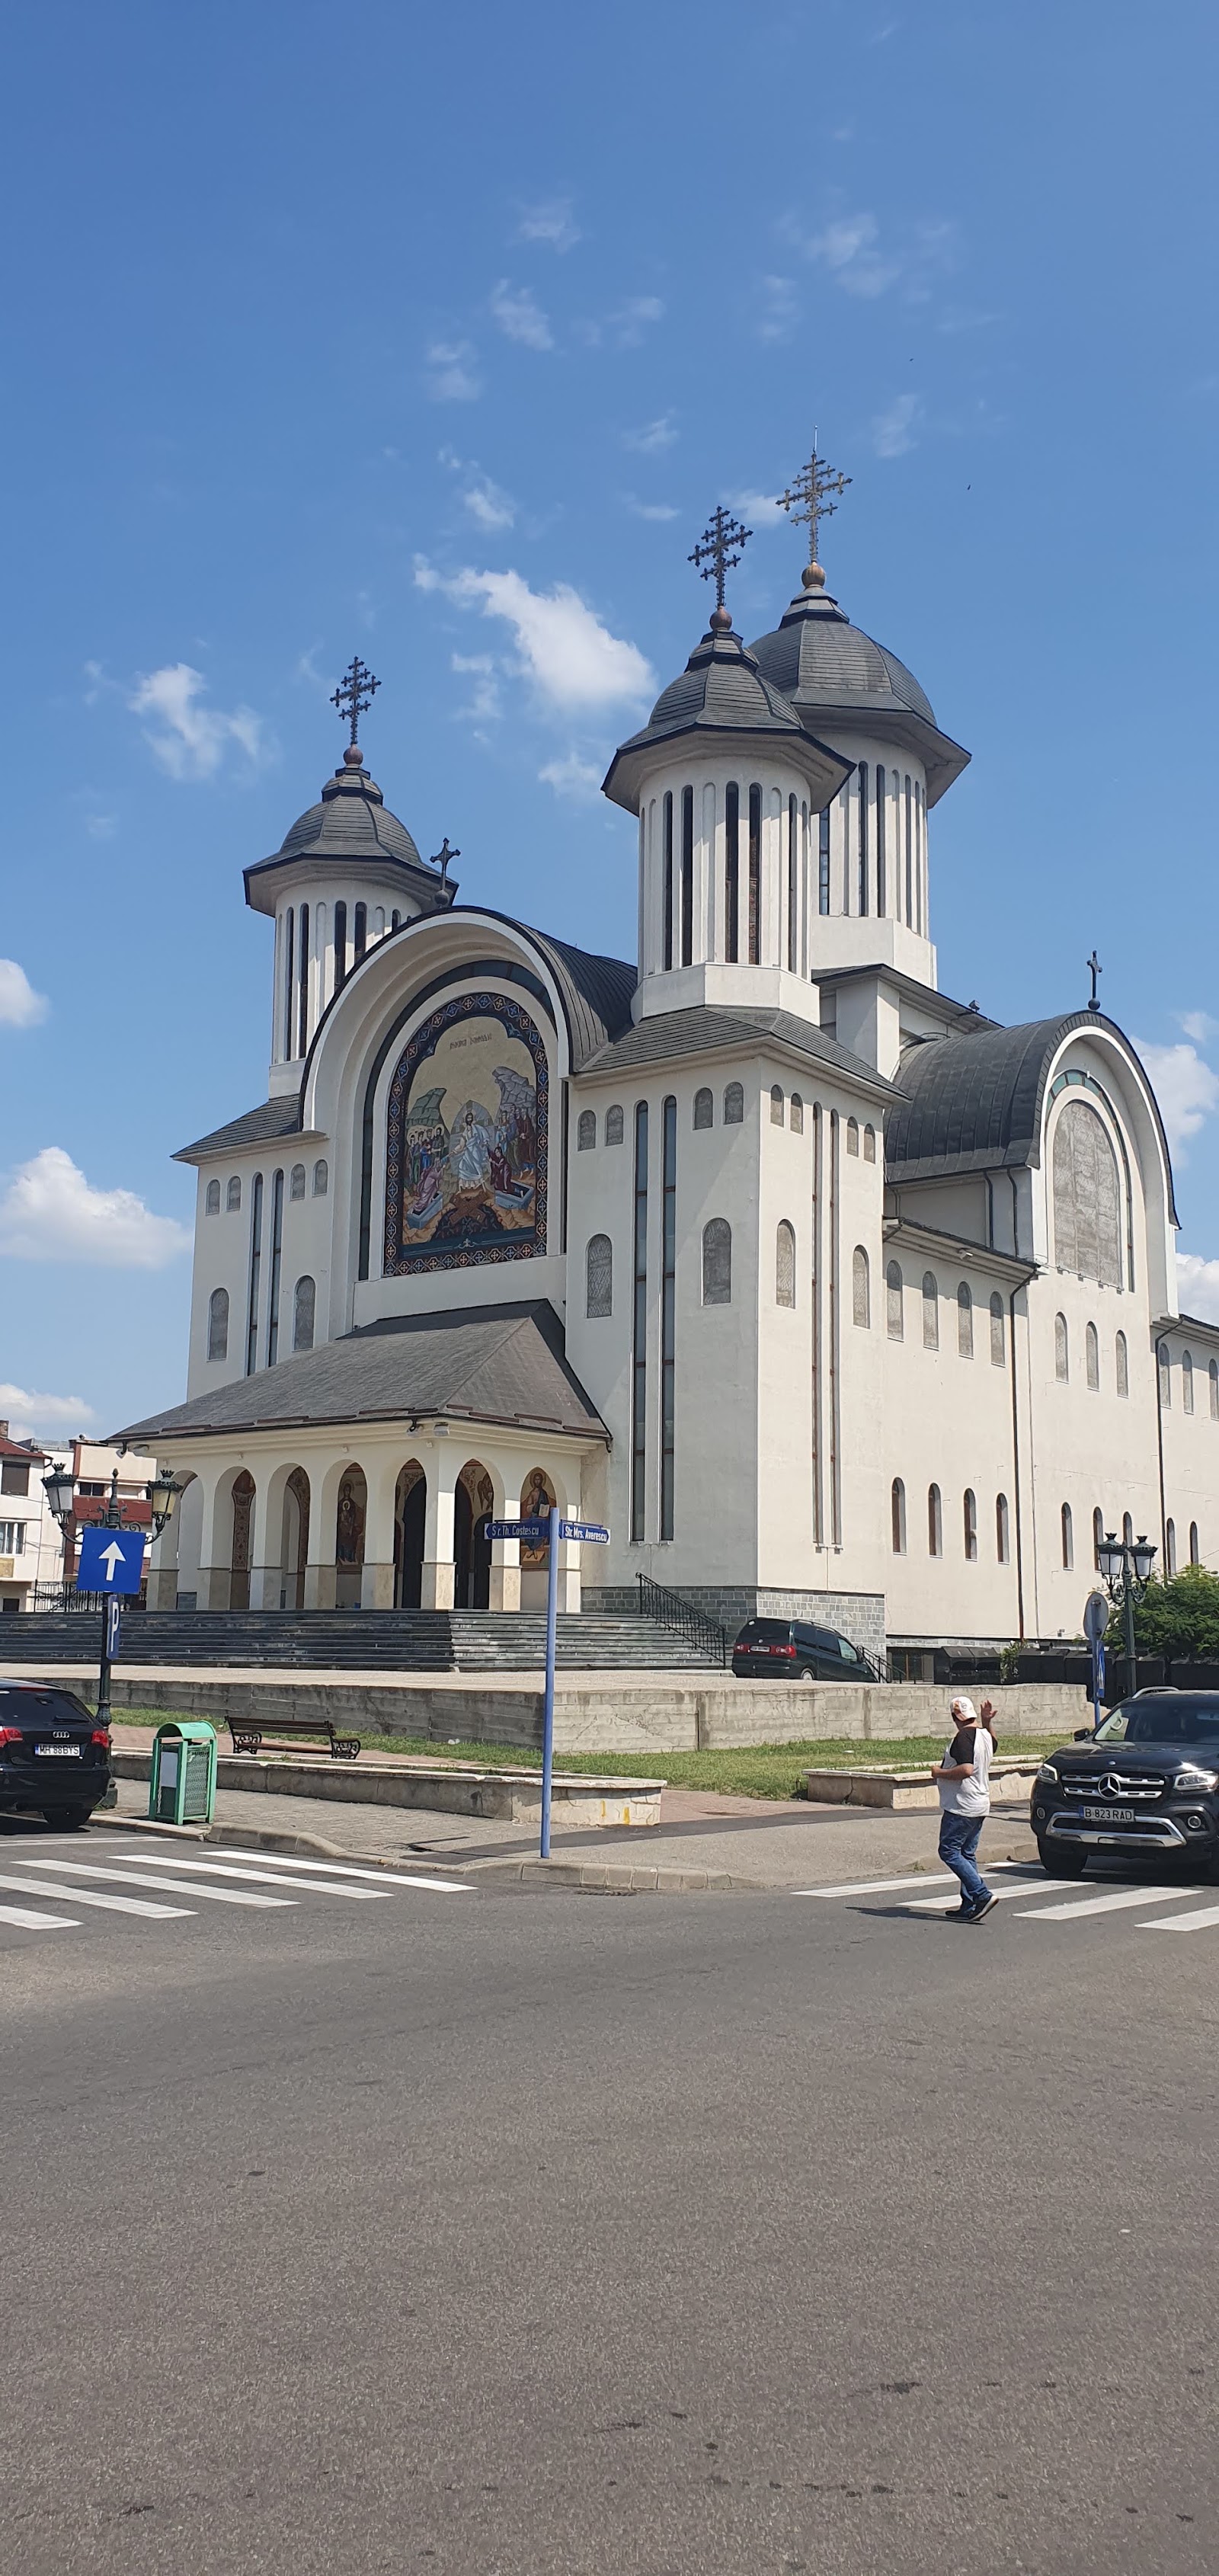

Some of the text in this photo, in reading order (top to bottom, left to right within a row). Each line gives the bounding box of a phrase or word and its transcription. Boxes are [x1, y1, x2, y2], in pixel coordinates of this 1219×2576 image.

[502, 1525, 510, 1535] Th.
[512, 1525, 539, 1535] Costescu
[585, 1528, 607, 1542] Averescu
[110, 1602, 119, 1652] P
[1095, 1809, 1110, 1819] 823
[1112, 1810, 1132, 1820] RAD
